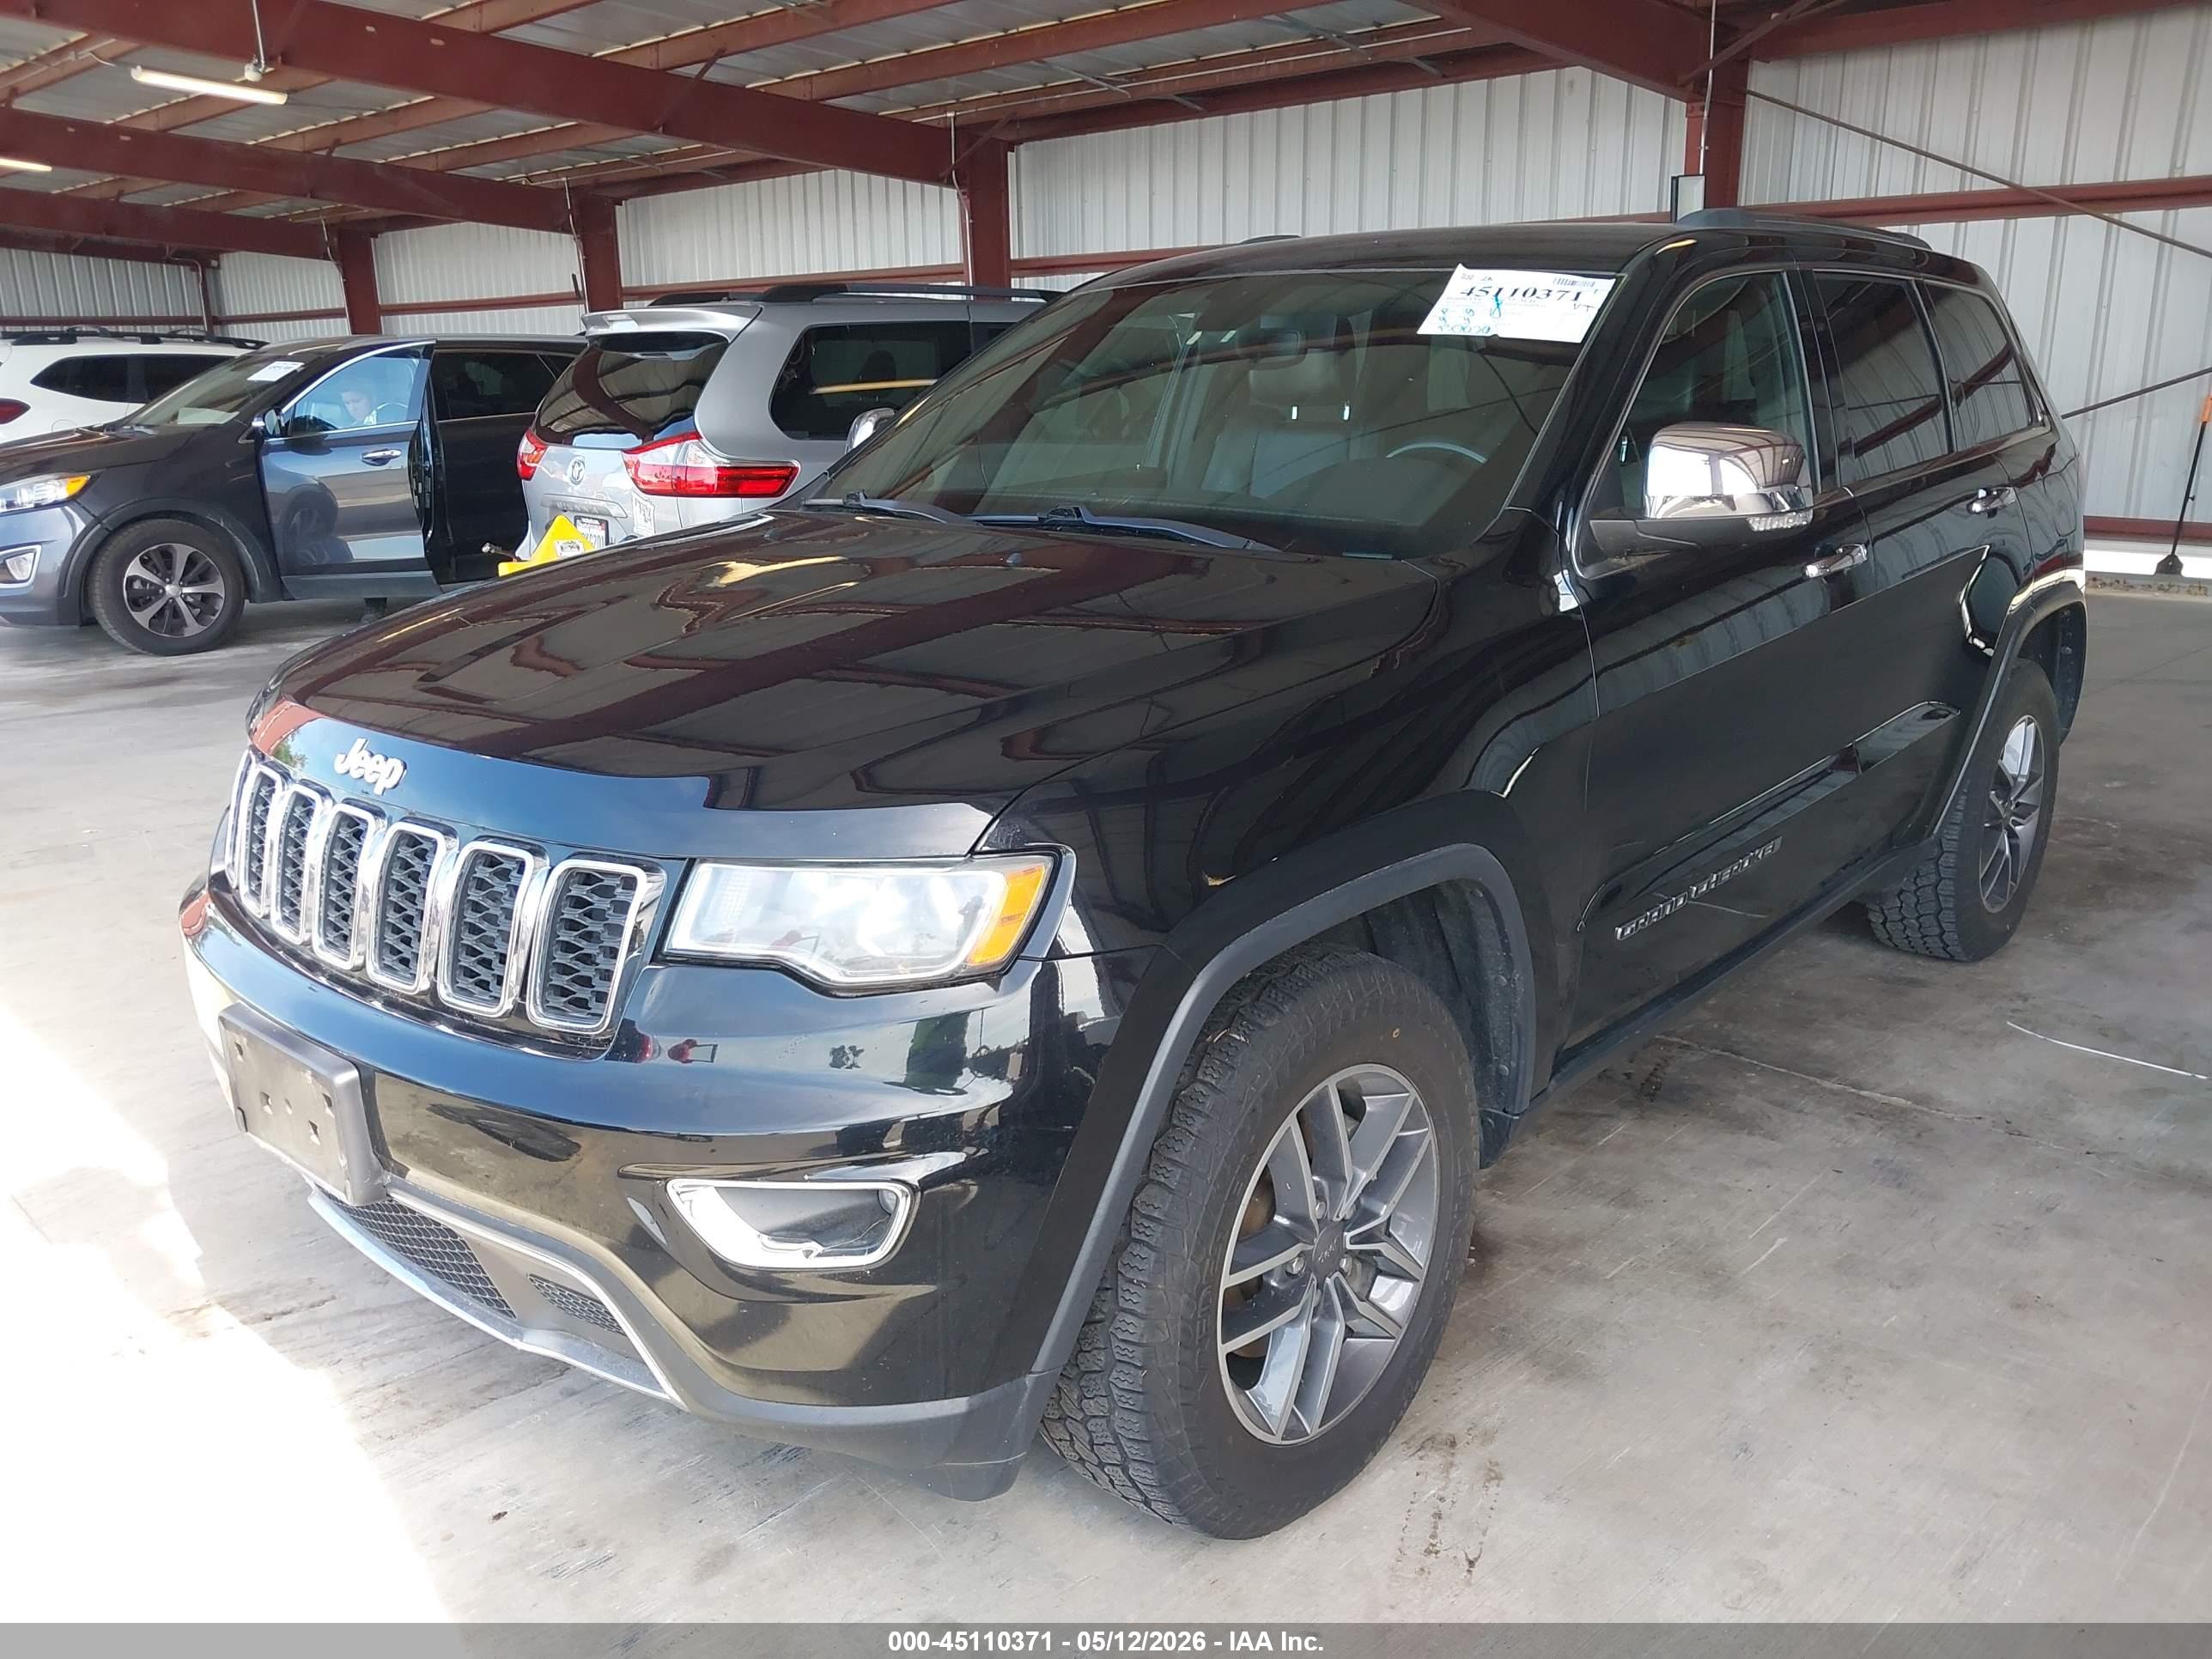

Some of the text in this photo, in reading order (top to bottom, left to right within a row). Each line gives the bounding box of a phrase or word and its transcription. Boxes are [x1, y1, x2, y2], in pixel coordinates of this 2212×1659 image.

[1460, 286, 1582, 301] 45110371
[333, 738, 408, 797] Jeep
[1615, 836, 1783, 941] GRAND CHEROKEE
